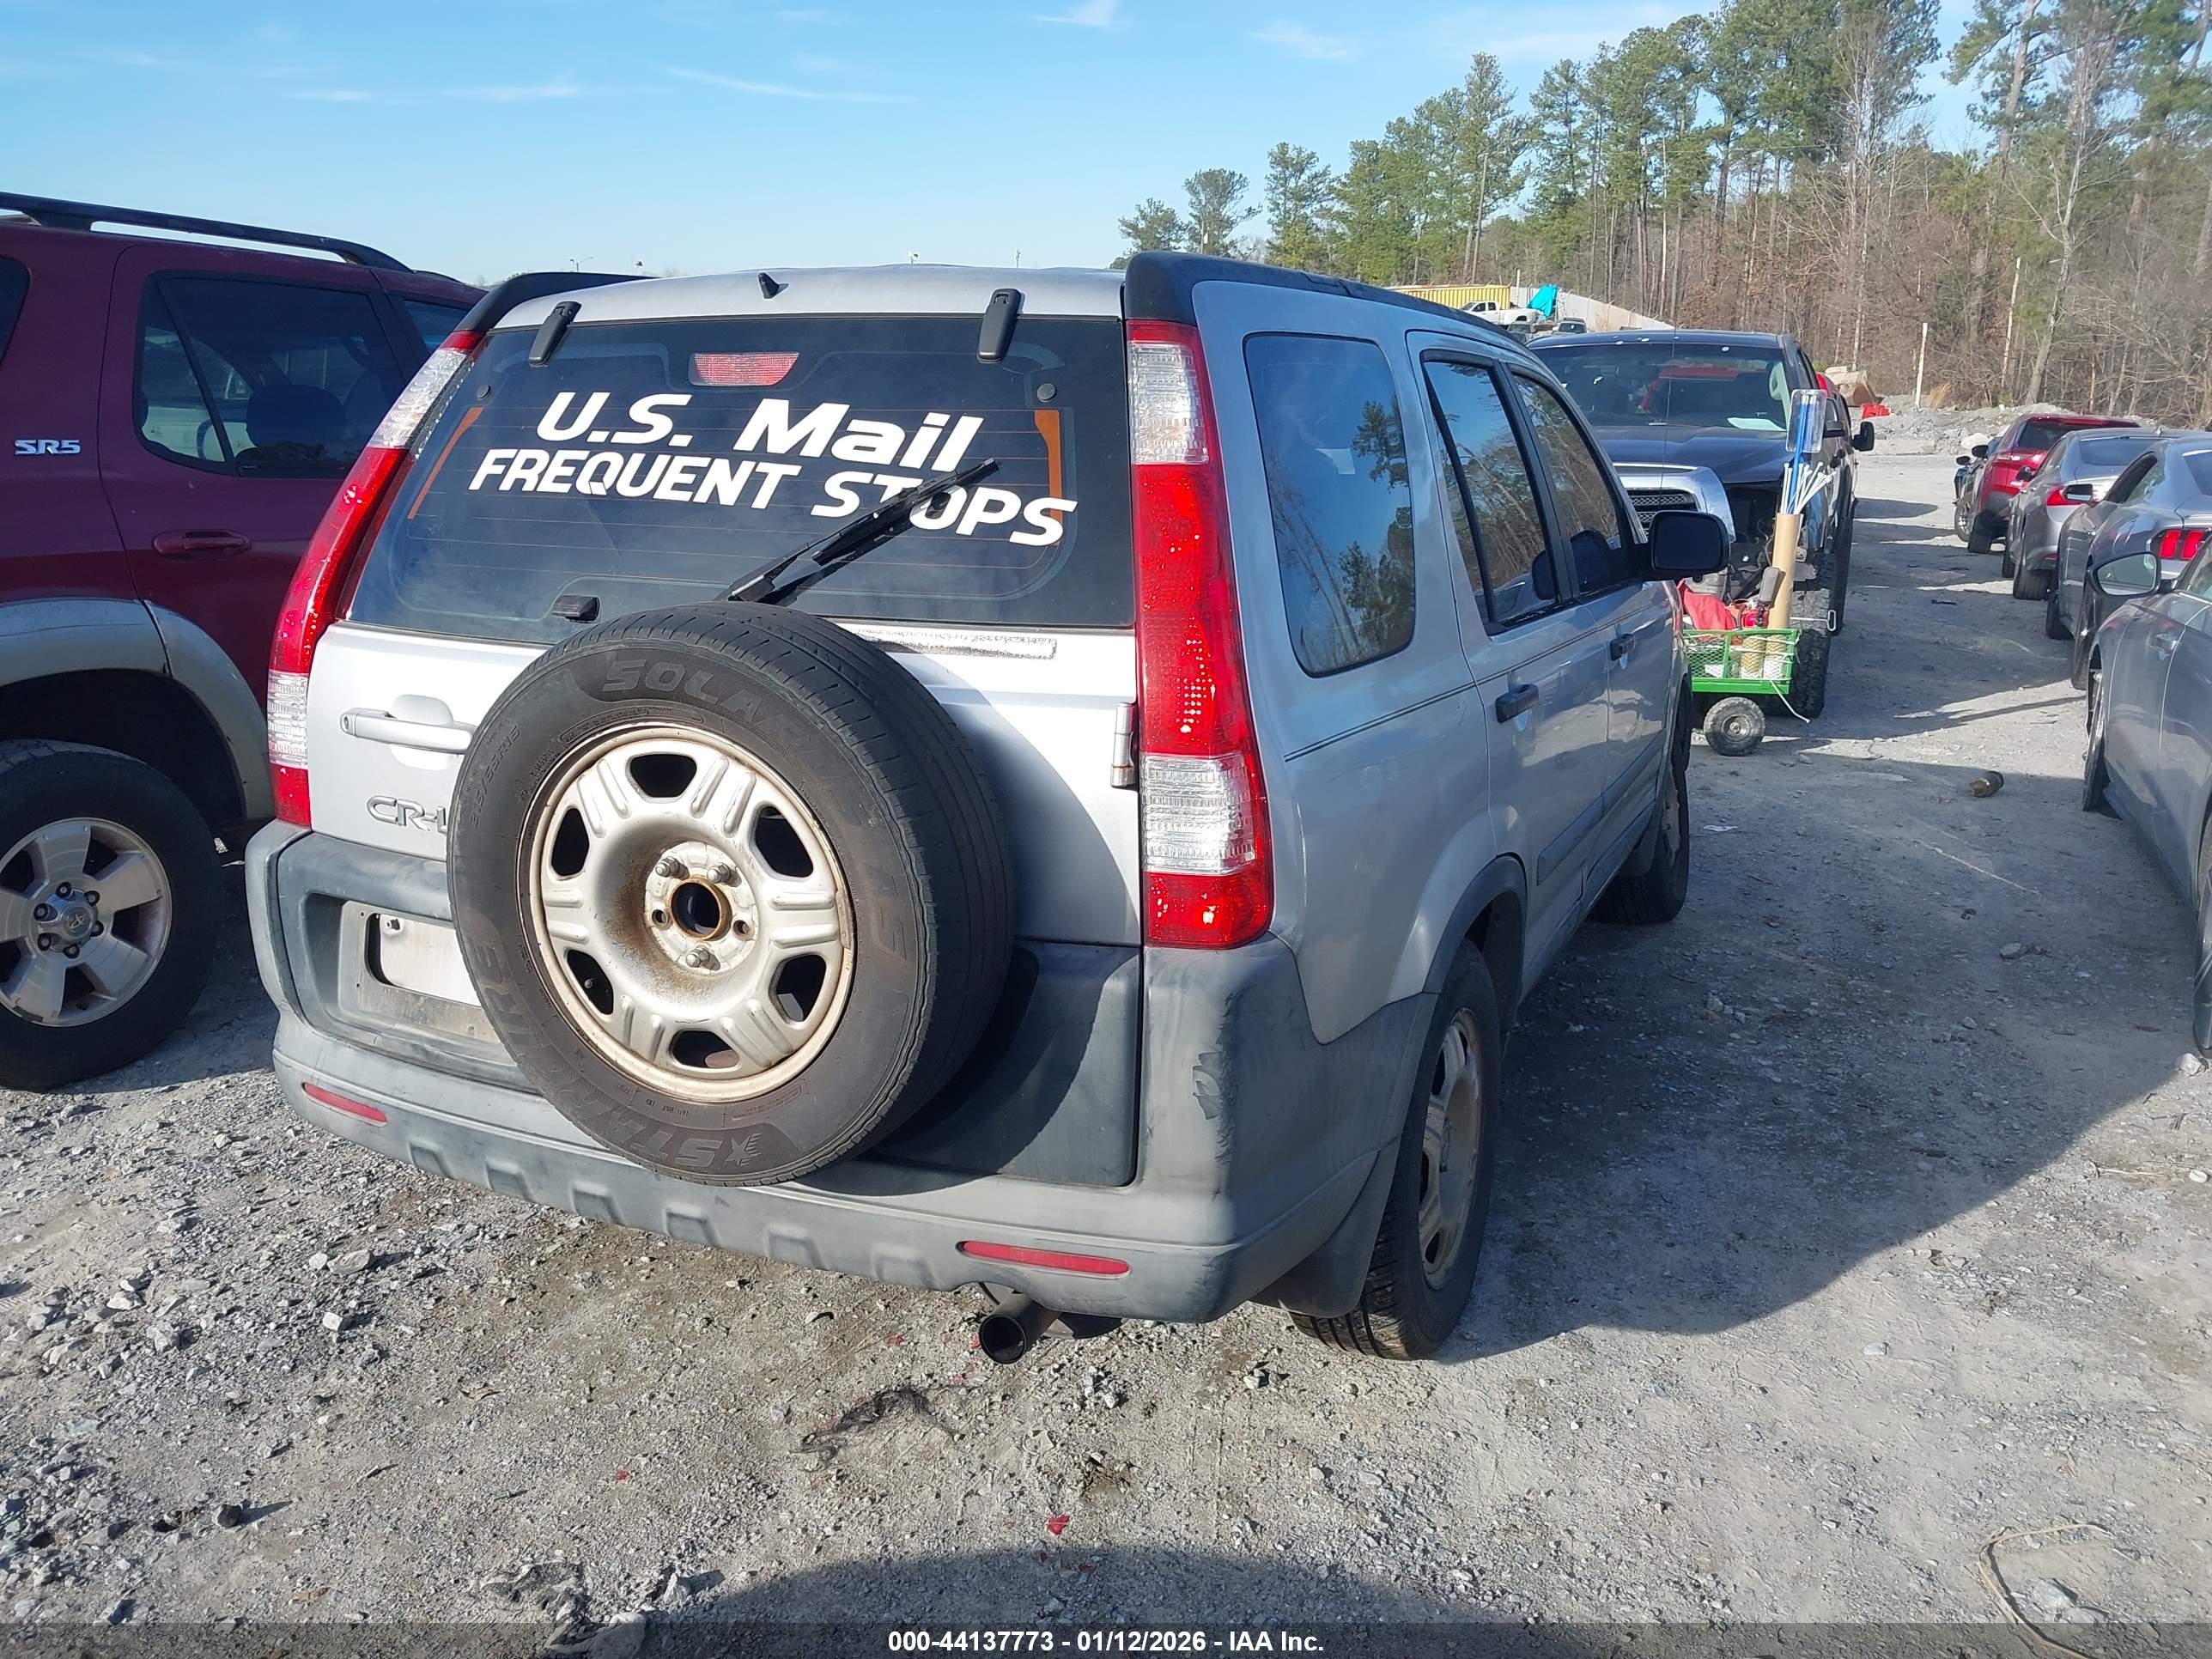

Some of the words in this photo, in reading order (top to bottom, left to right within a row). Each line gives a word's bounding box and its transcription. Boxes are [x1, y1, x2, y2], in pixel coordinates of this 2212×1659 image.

[15, 439, 81, 454] SR5
[537, 392, 693, 447] U.S.
[732, 398, 984, 472] Mail
[468, 448, 802, 510] FREQUENT
[811, 471, 1079, 546] STOPS
